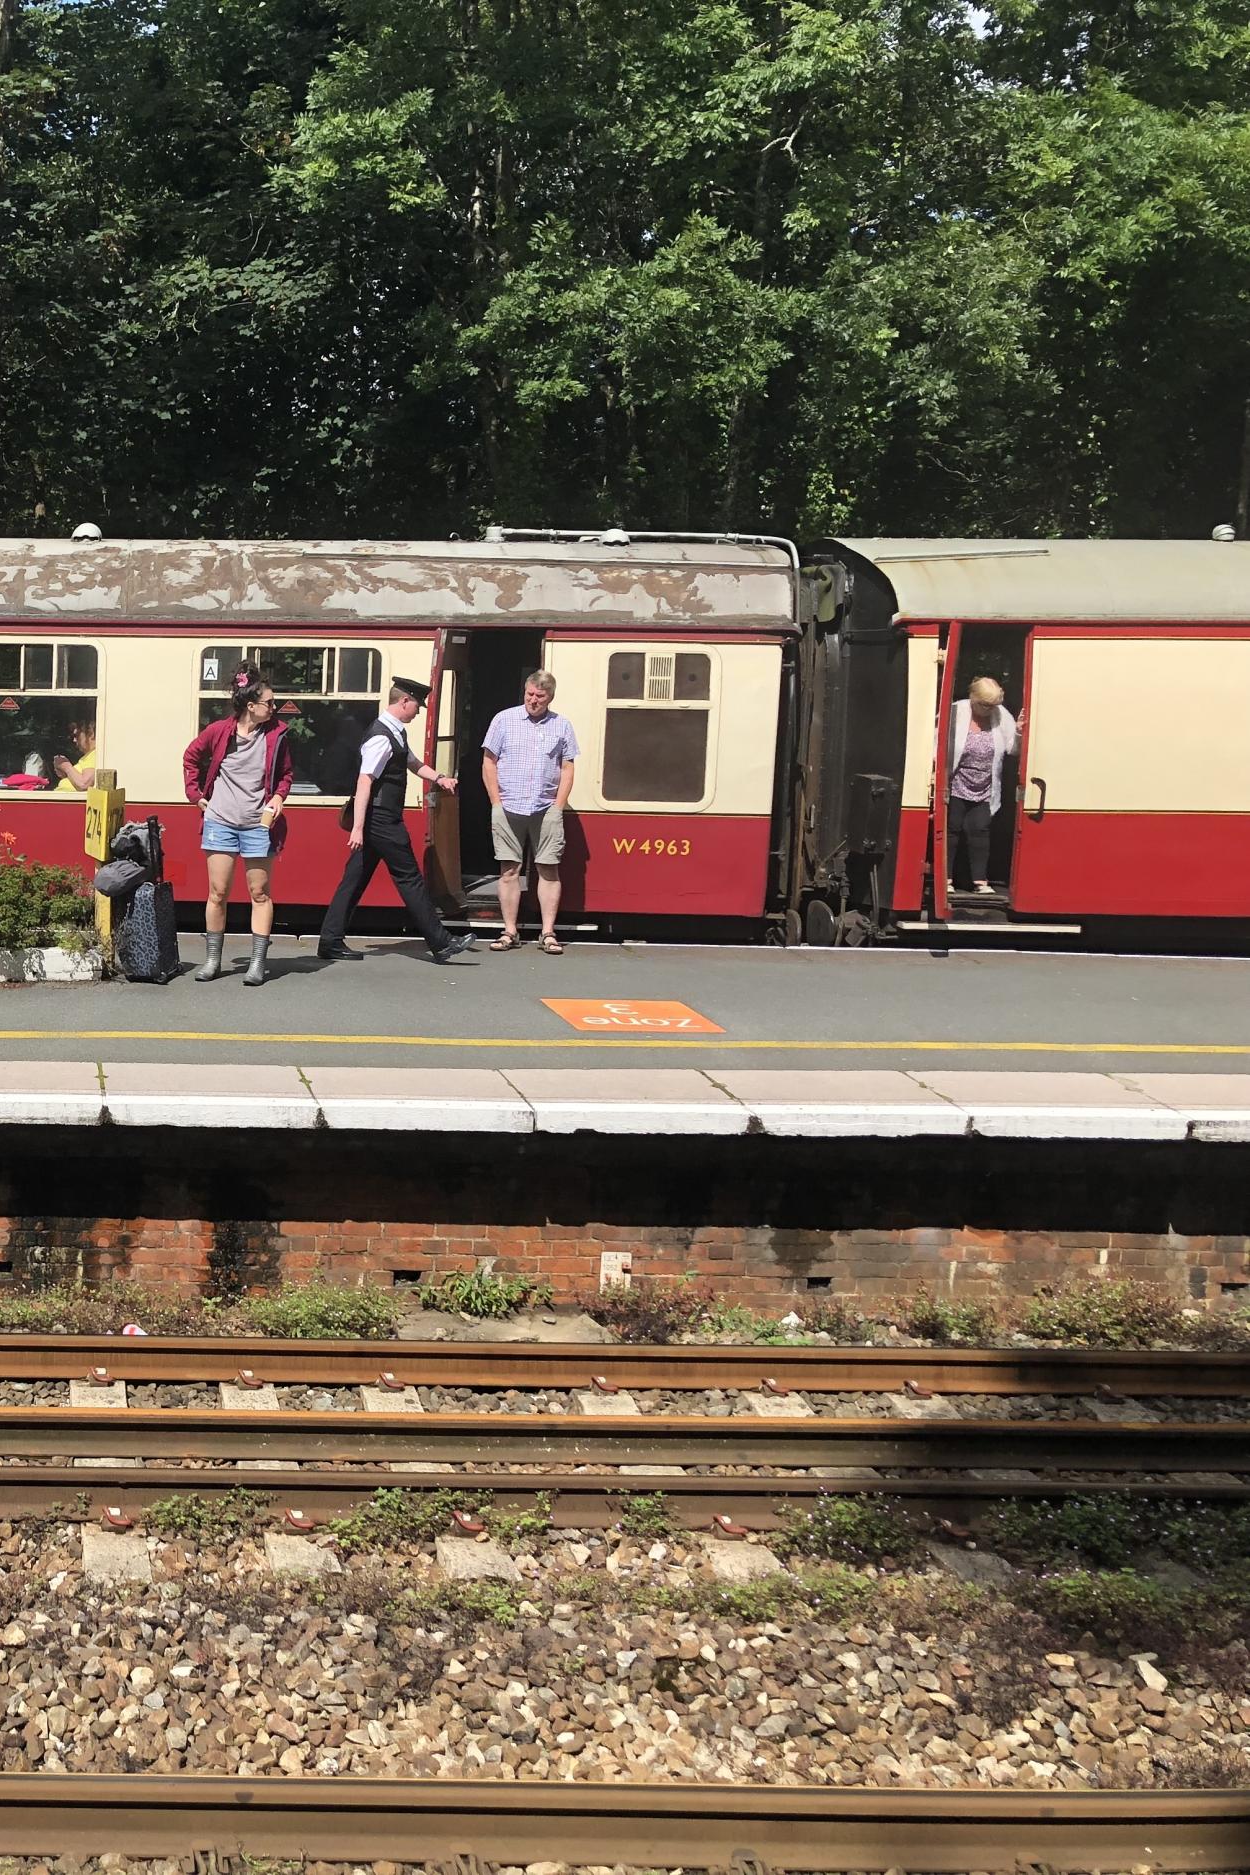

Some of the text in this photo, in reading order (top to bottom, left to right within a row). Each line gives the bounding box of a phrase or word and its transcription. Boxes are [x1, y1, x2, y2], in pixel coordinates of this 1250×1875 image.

[205, 666, 216, 679] A
[86, 806, 102, 844] 274
[582, 1016, 702, 1028] Zone
